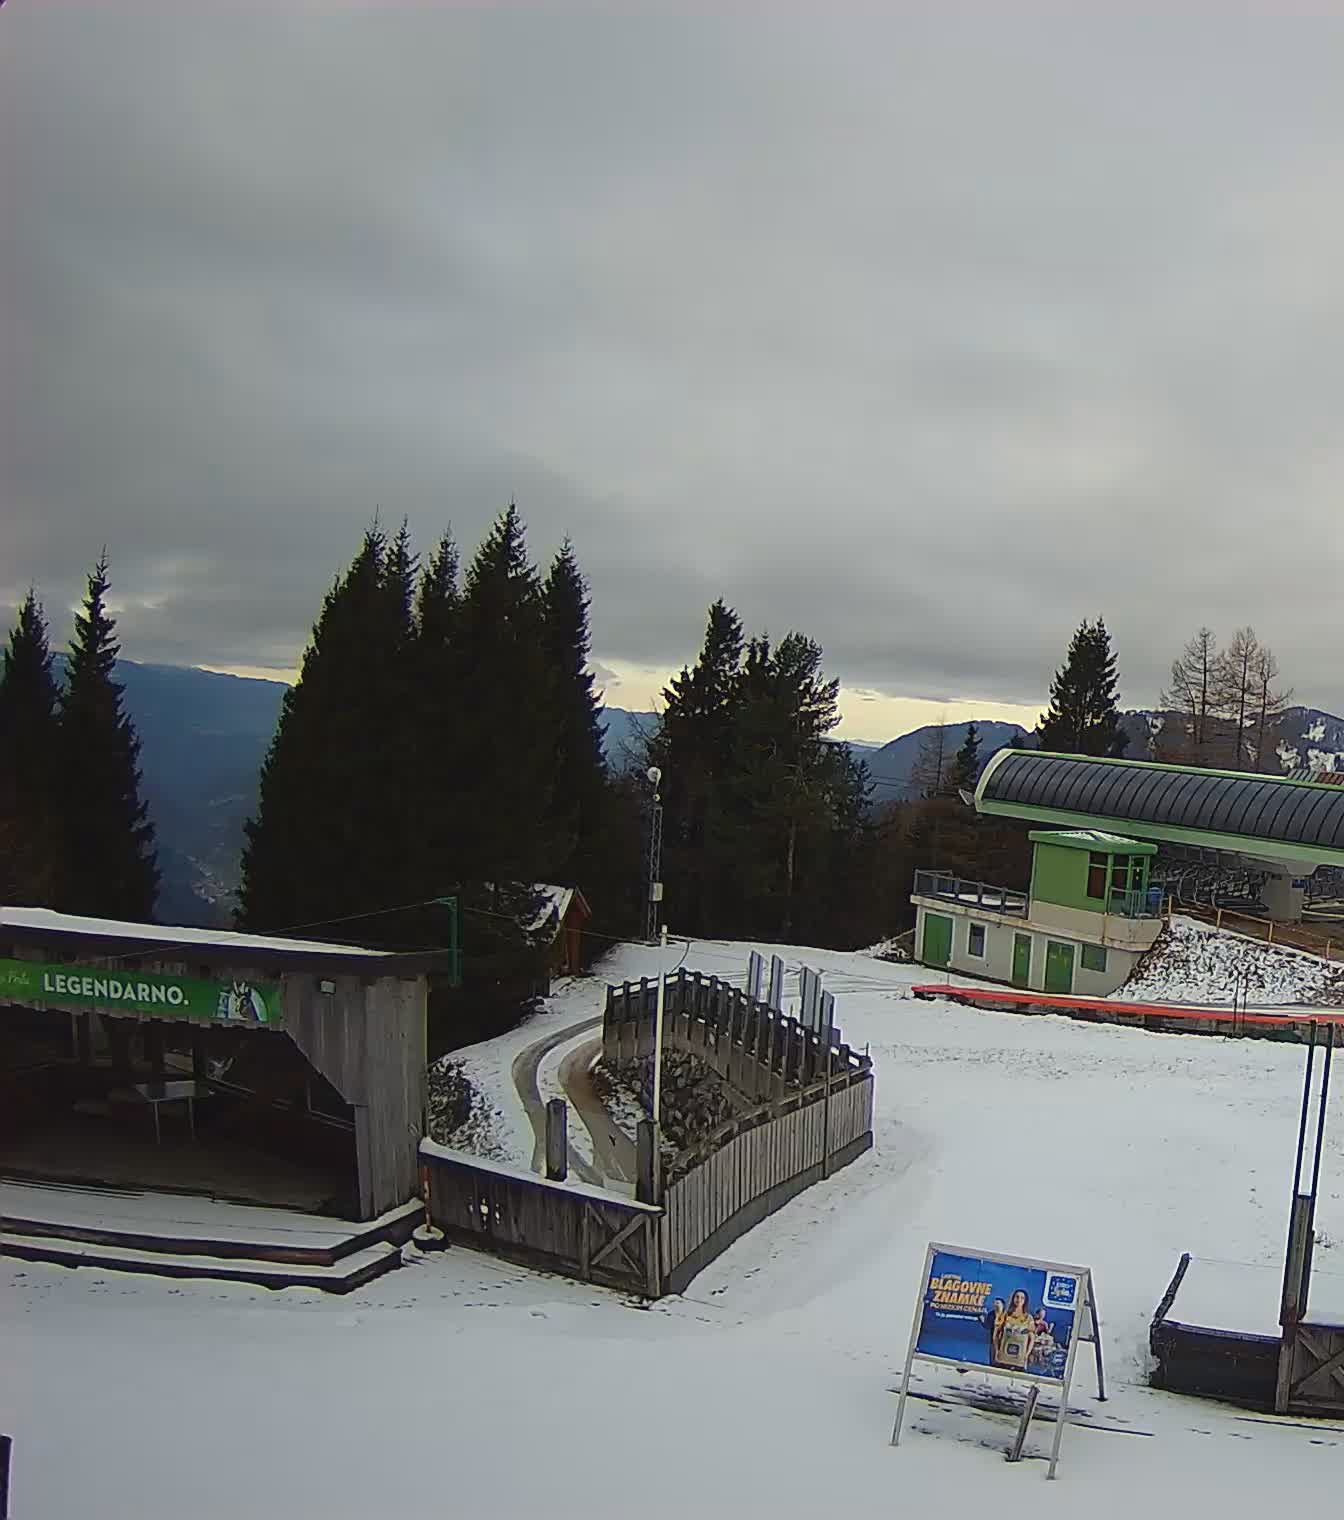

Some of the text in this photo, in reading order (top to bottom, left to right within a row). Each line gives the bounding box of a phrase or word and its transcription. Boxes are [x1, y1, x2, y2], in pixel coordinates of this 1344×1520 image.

[43, 972, 190, 1006] LEGENDARNO.
[930, 1278, 993, 1296] BLAGOVNE
[932, 1291, 986, 1306] ZNAMKE
